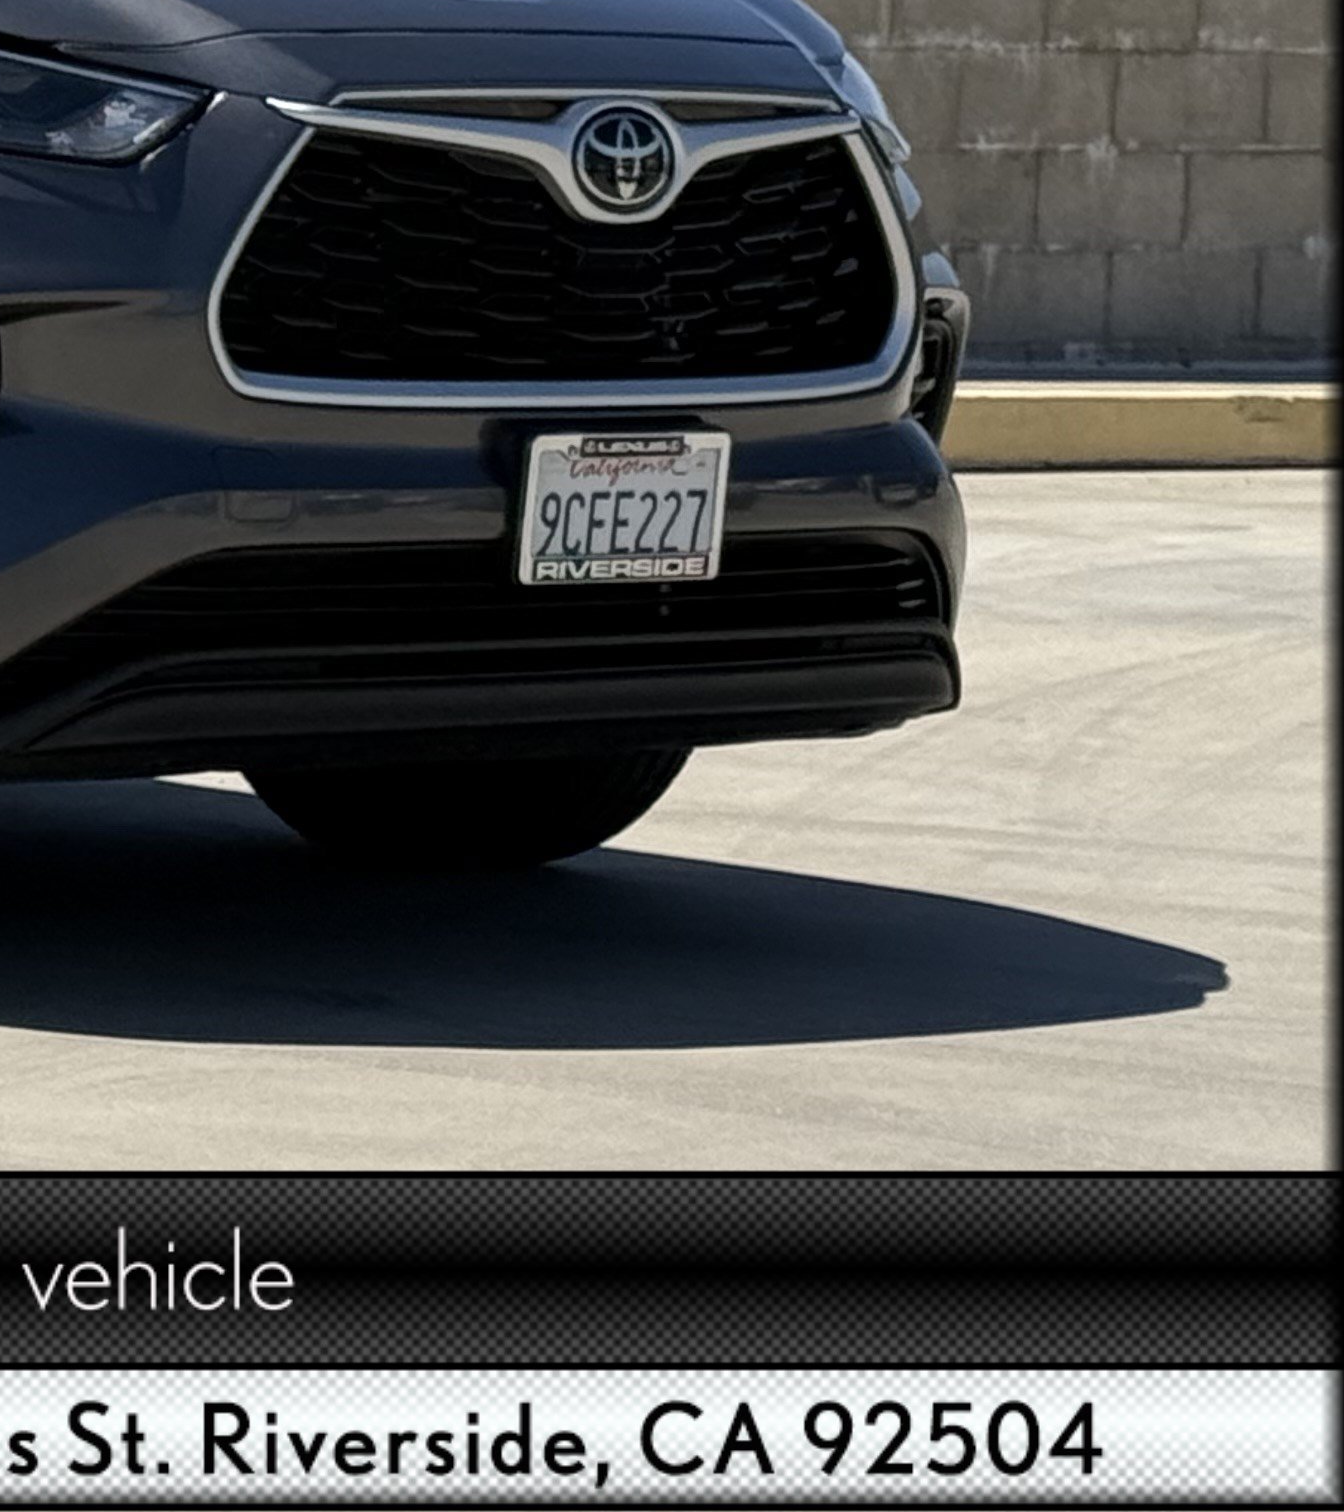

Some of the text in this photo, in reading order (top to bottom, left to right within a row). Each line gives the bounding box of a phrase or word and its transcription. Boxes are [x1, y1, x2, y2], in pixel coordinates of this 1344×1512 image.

[597, 439, 669, 453] LEXUS
[569, 456, 687, 486] California
[537, 489, 708, 556] 9CFE227
[536, 557, 705, 581] RIVERSIDE
